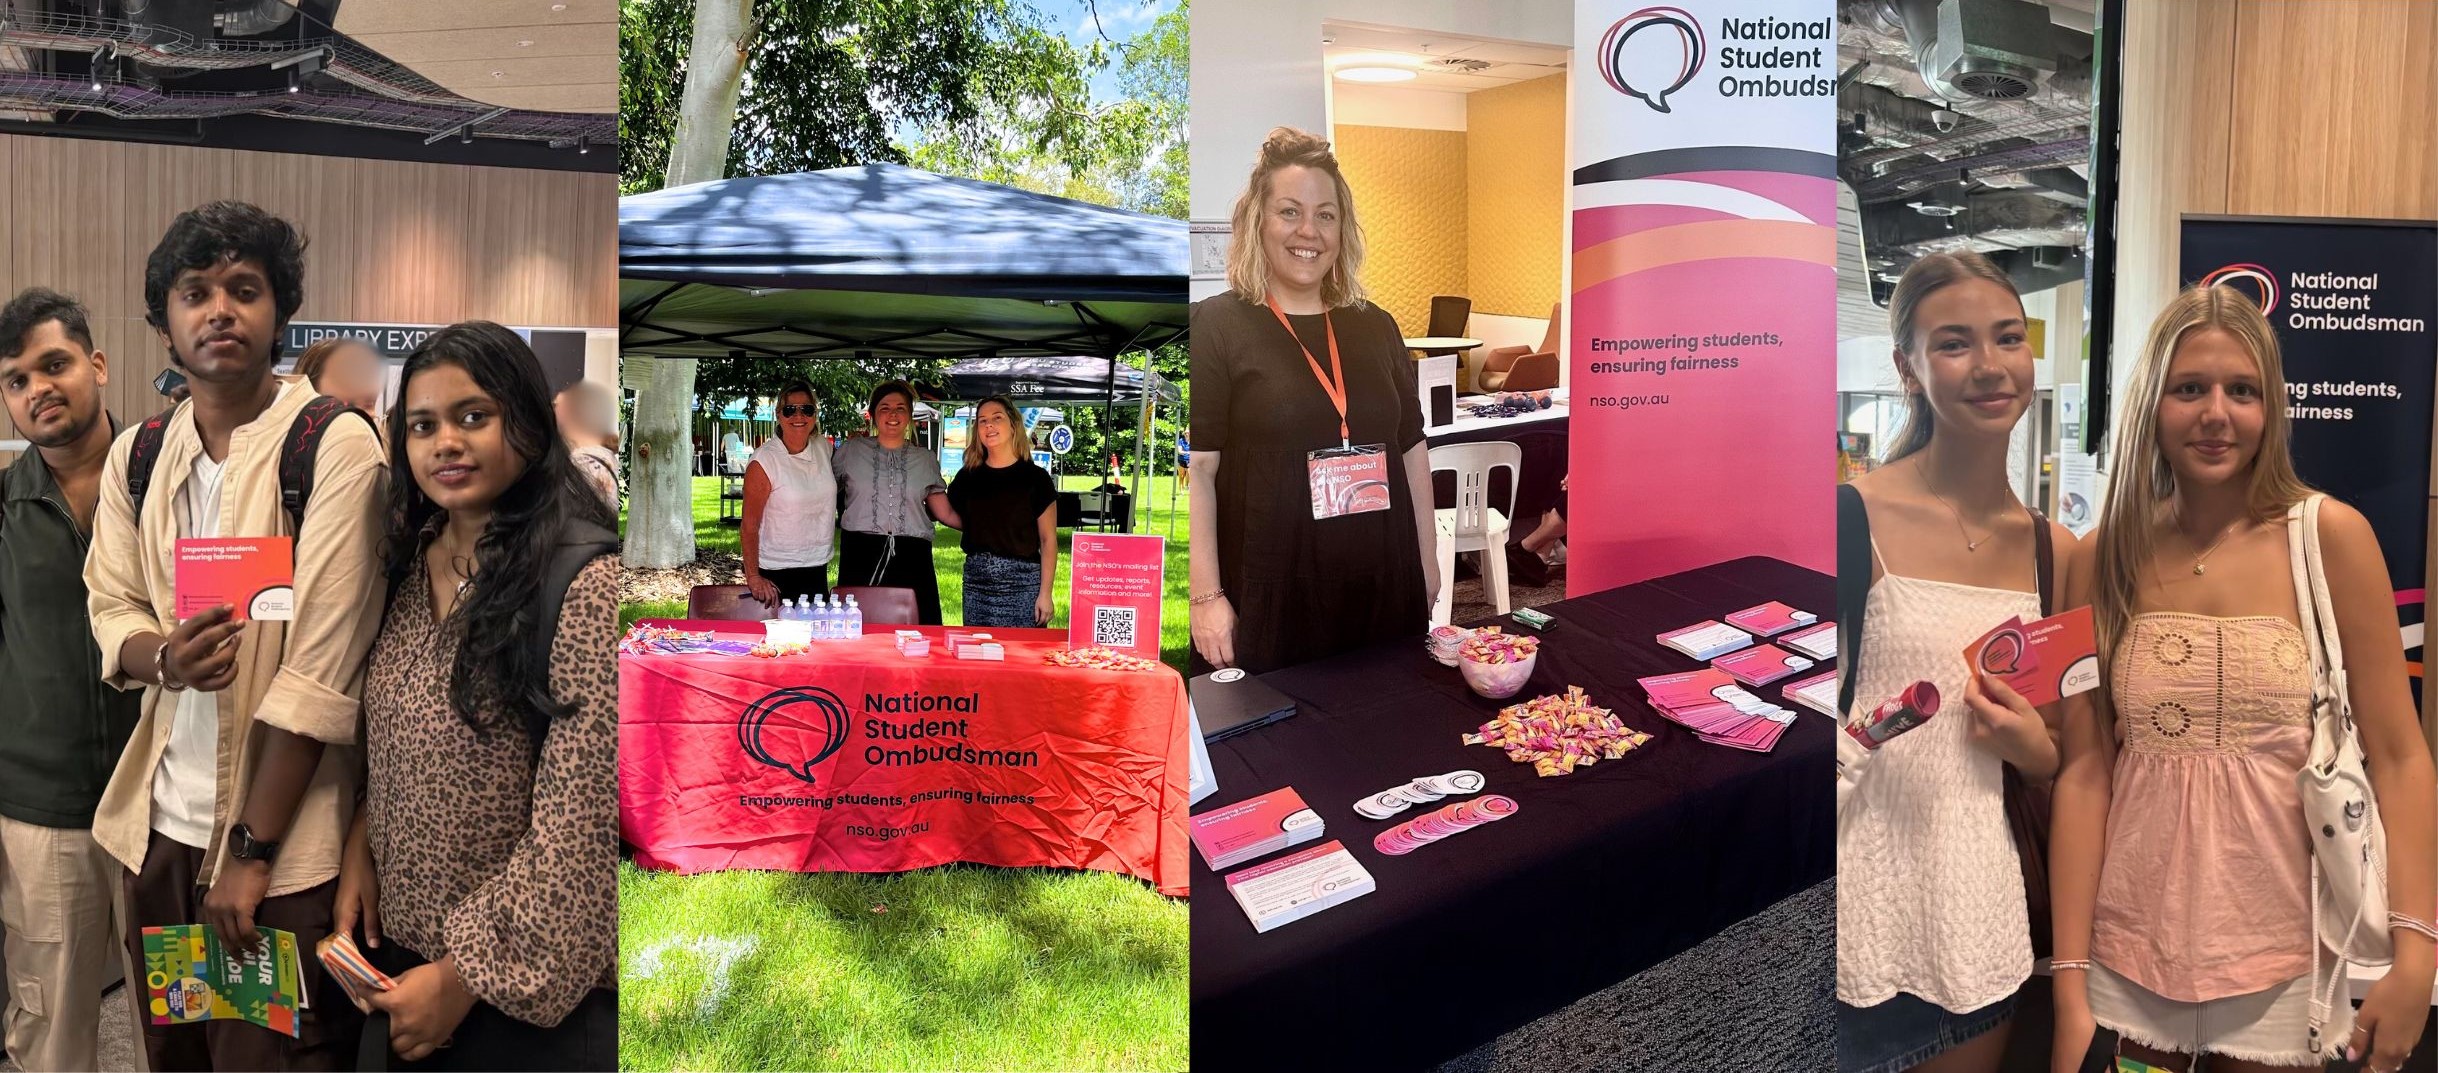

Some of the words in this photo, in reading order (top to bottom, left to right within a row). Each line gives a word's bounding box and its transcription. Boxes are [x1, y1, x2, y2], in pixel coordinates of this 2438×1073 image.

[1722, 16, 1832, 40] National
[1720, 46, 1821, 69] Student
[2291, 271, 2378, 290] National
[2290, 293, 2371, 310] Student
[2289, 313, 2425, 332] Ombudsman
[387, 330, 436, 350] EXP
[1591, 334, 1699, 355] Empowering
[1702, 331, 1784, 348] students,
[1590, 357, 1667, 375] ensuring
[1670, 355, 1739, 371] fairness
[1010, 384, 1028, 393] SSA
[1029, 384, 1045, 393] Fee
[2312, 381, 2402, 399] students,
[1590, 394, 1669, 409] nso.gov.au
[2284, 403, 2353, 419] airness
[1350, 461, 1377, 471] about
[182, 546, 225, 554] Empowering
[182, 554, 213, 562] ensuring
[1122, 563, 1148, 571] mailing
[865, 691, 979, 714] National
[864, 717, 969, 740] Student
[864, 742, 1039, 768] Ombudsman
[740, 794, 833, 810] Empowering
[836, 792, 907, 807] students,
[909, 787, 973, 805] ensuring
[976, 791, 1035, 806] fairness
[846, 820, 930, 842] nso.gov.au
[243, 948, 257, 966] NI
[257, 935, 273, 986] YOUR
[226, 955, 242, 984] IDE
